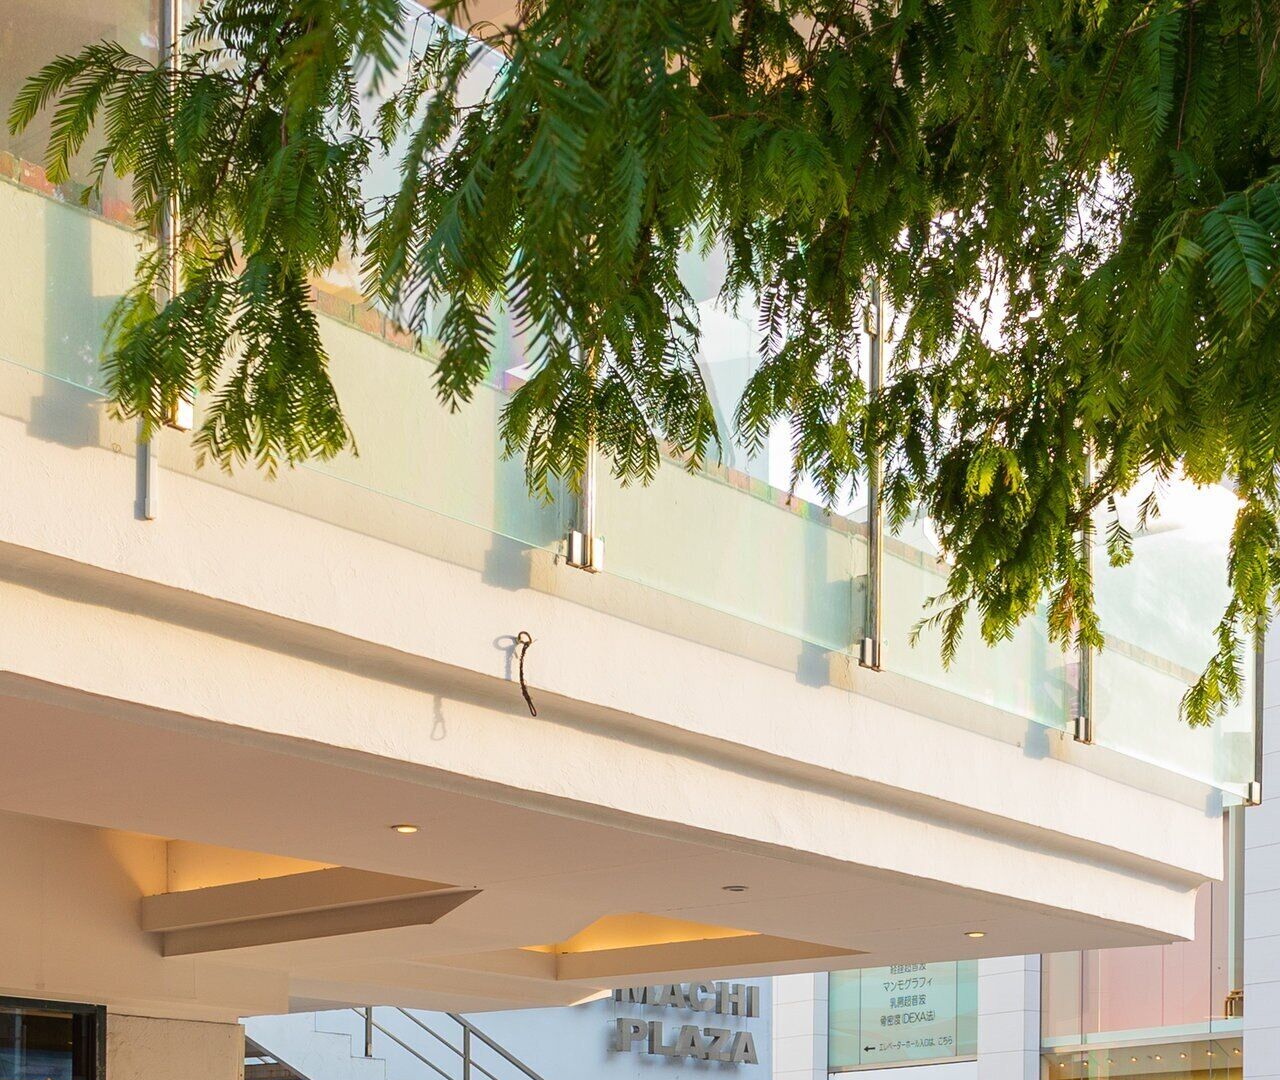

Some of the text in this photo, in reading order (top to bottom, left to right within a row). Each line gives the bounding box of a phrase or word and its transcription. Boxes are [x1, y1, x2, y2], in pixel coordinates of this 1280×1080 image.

[883, 977, 933, 992] マンモグラフィ
[616, 1017, 759, 1065] PLAZA
